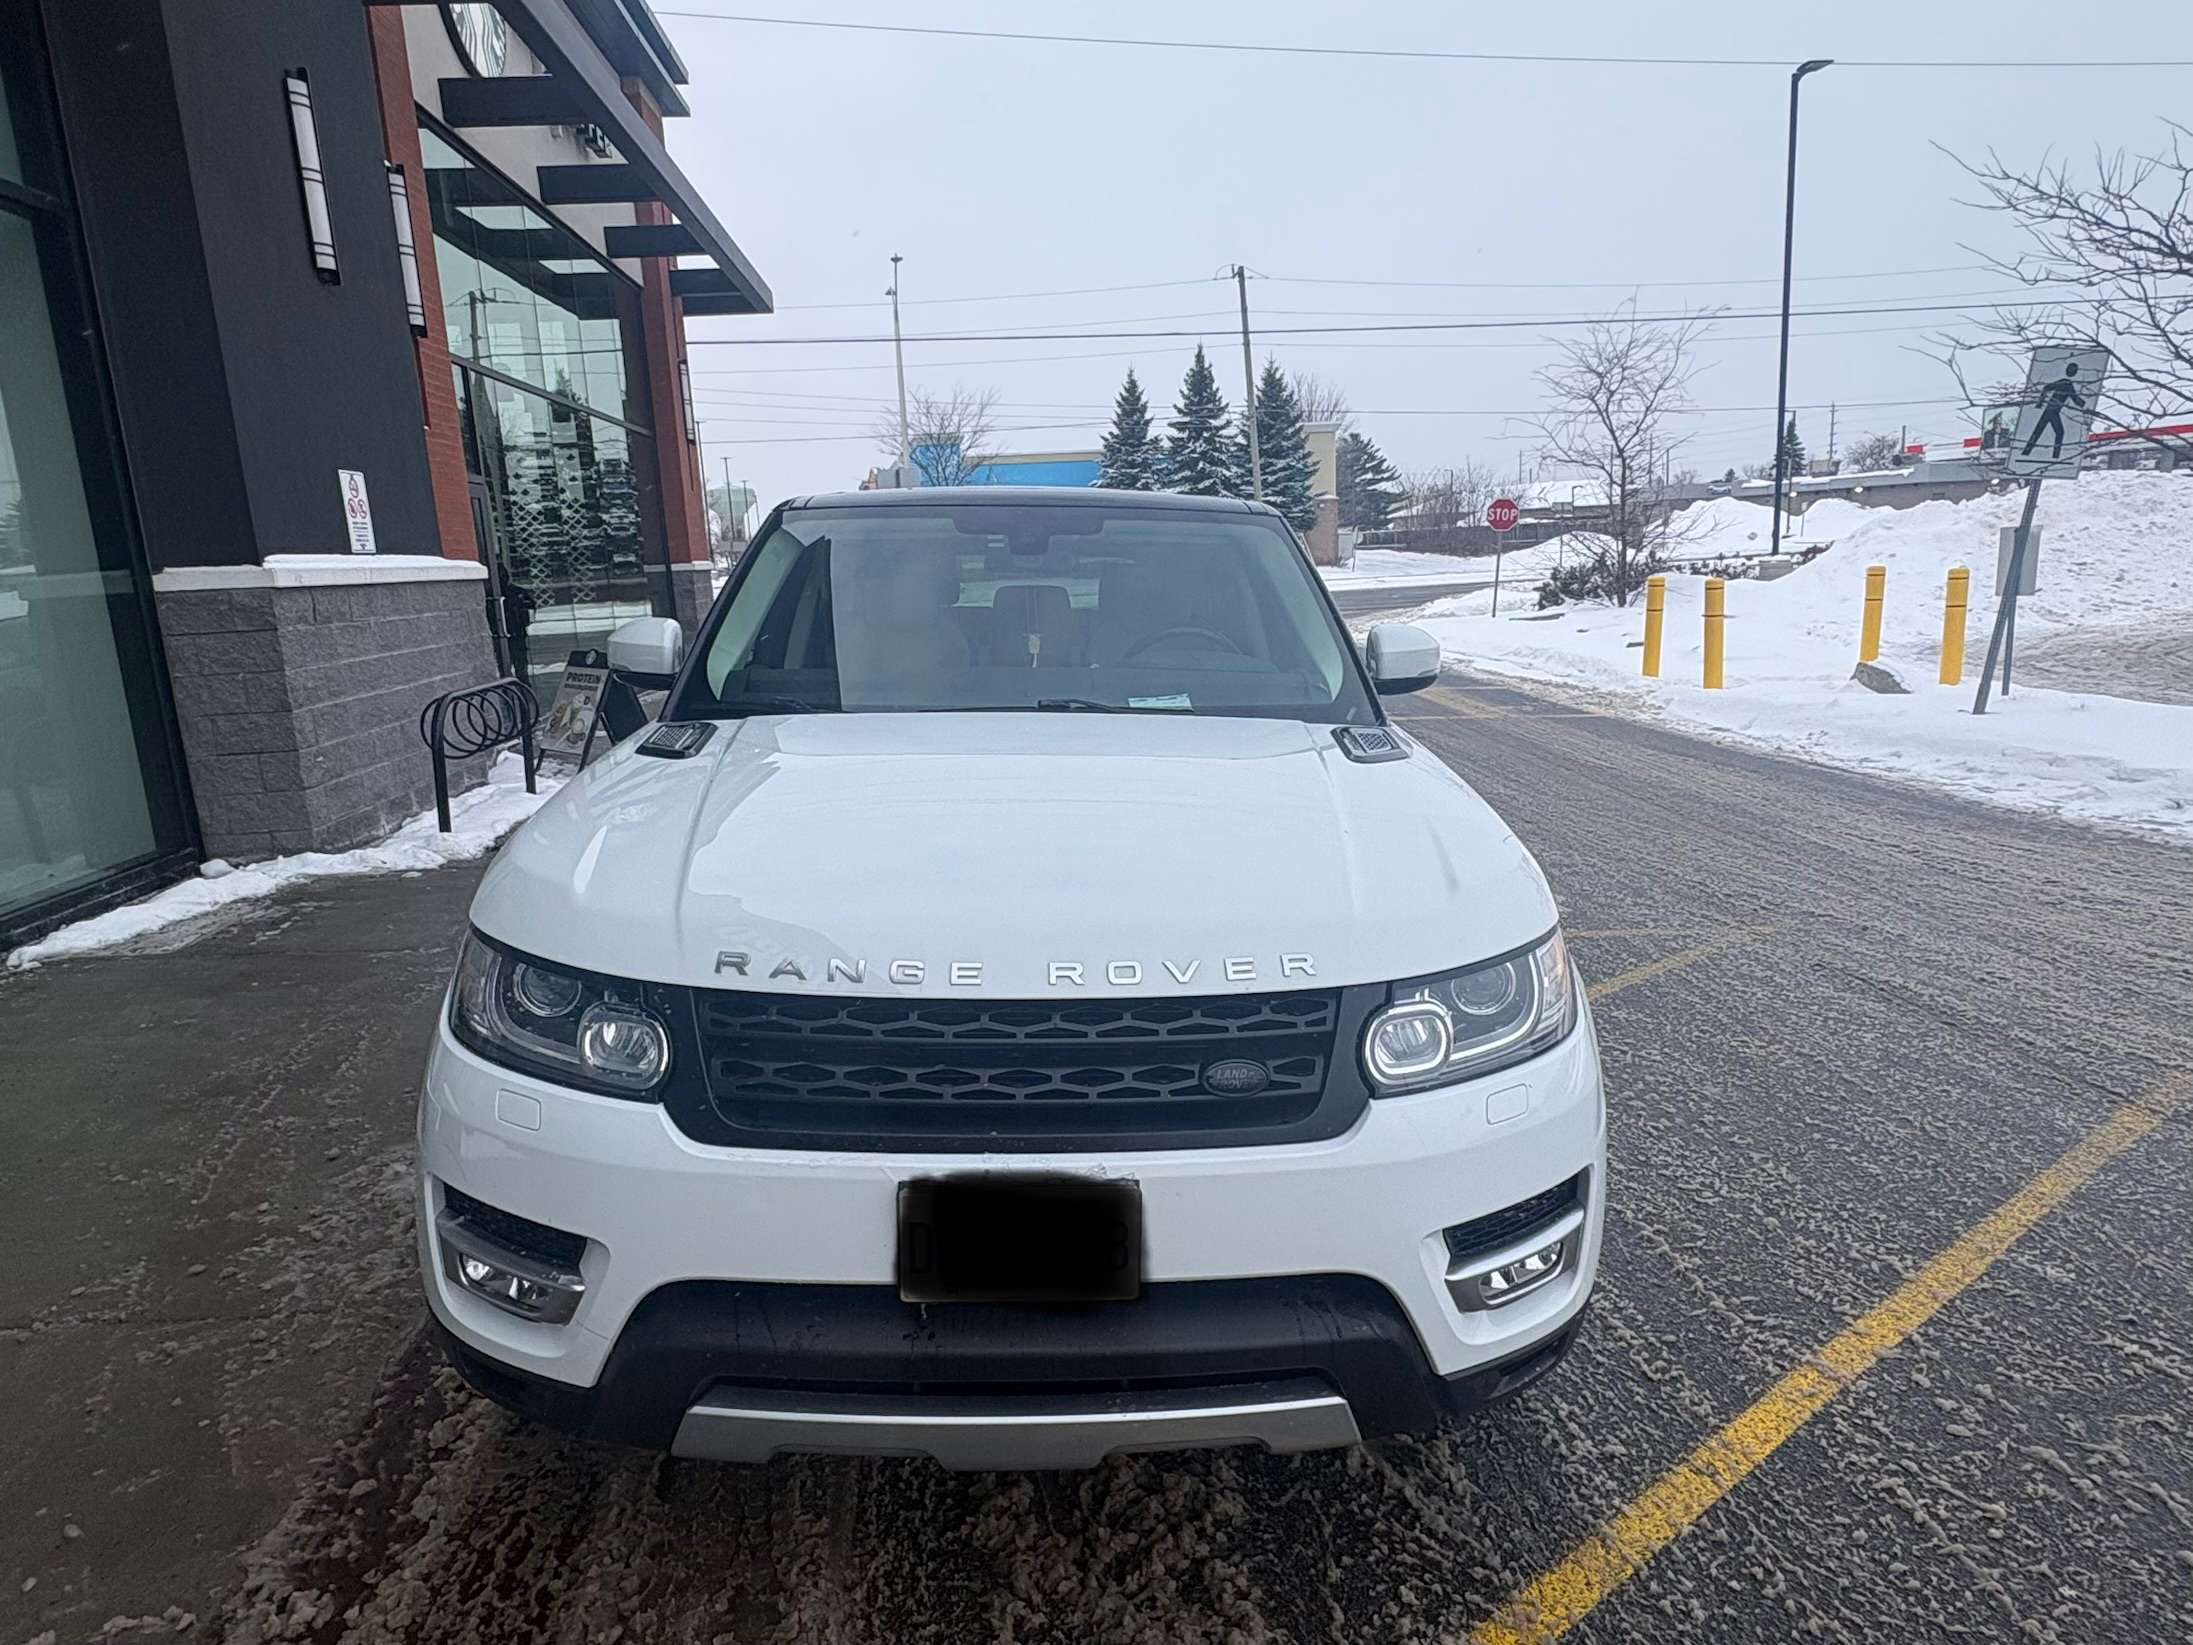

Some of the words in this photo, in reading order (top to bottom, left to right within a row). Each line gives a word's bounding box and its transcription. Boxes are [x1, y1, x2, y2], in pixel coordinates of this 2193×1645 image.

[1488, 508, 1518, 521] STOP
[566, 672, 601, 684] PROTEIN
[714, 950, 984, 986] RANGE
[1047, 952, 1318, 986] ROVER
